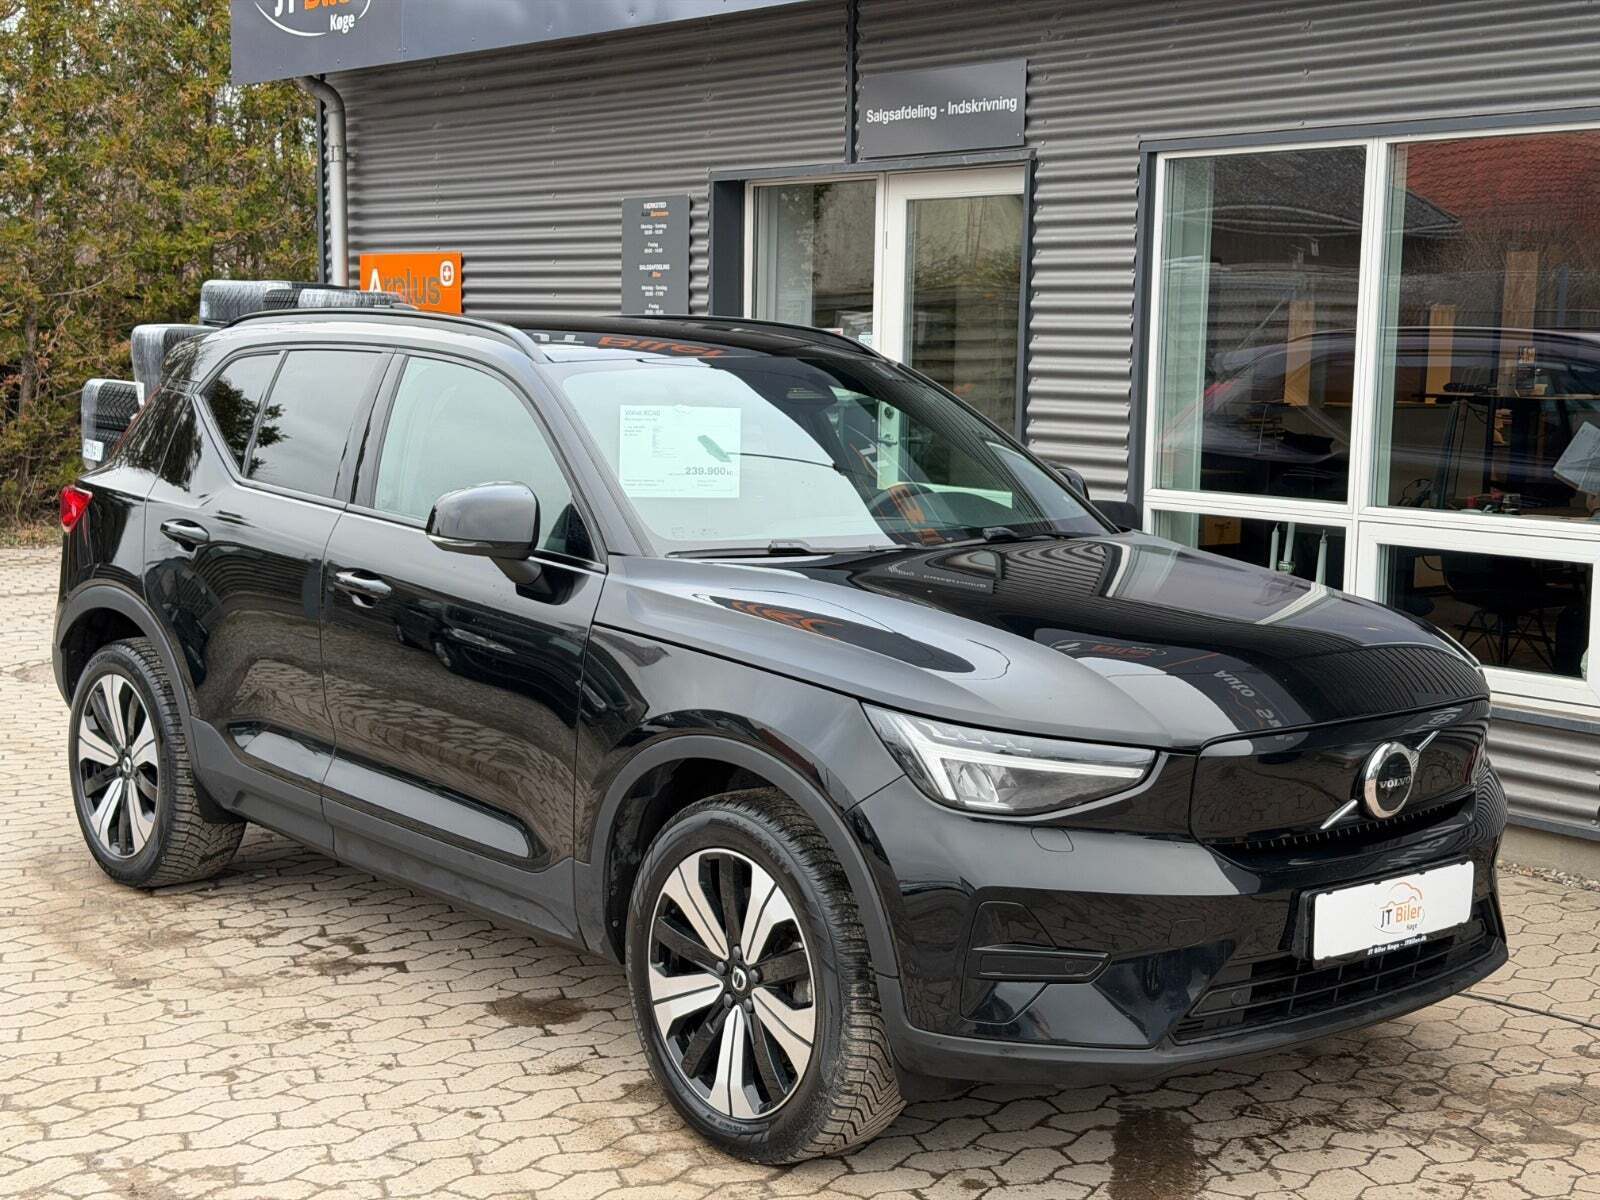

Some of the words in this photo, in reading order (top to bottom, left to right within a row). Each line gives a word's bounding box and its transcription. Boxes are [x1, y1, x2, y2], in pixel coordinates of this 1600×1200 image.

[330, 14, 355, 34] Køge
[866, 104, 937, 124] Salgsafdeling
[948, 96, 1017, 115] Indskrivning
[685, 466, 726, 476] 239.900
[1379, 776, 1411, 789] VOLVO
[1380, 908, 1393, 928] JT
[1396, 904, 1422, 923] Biler
